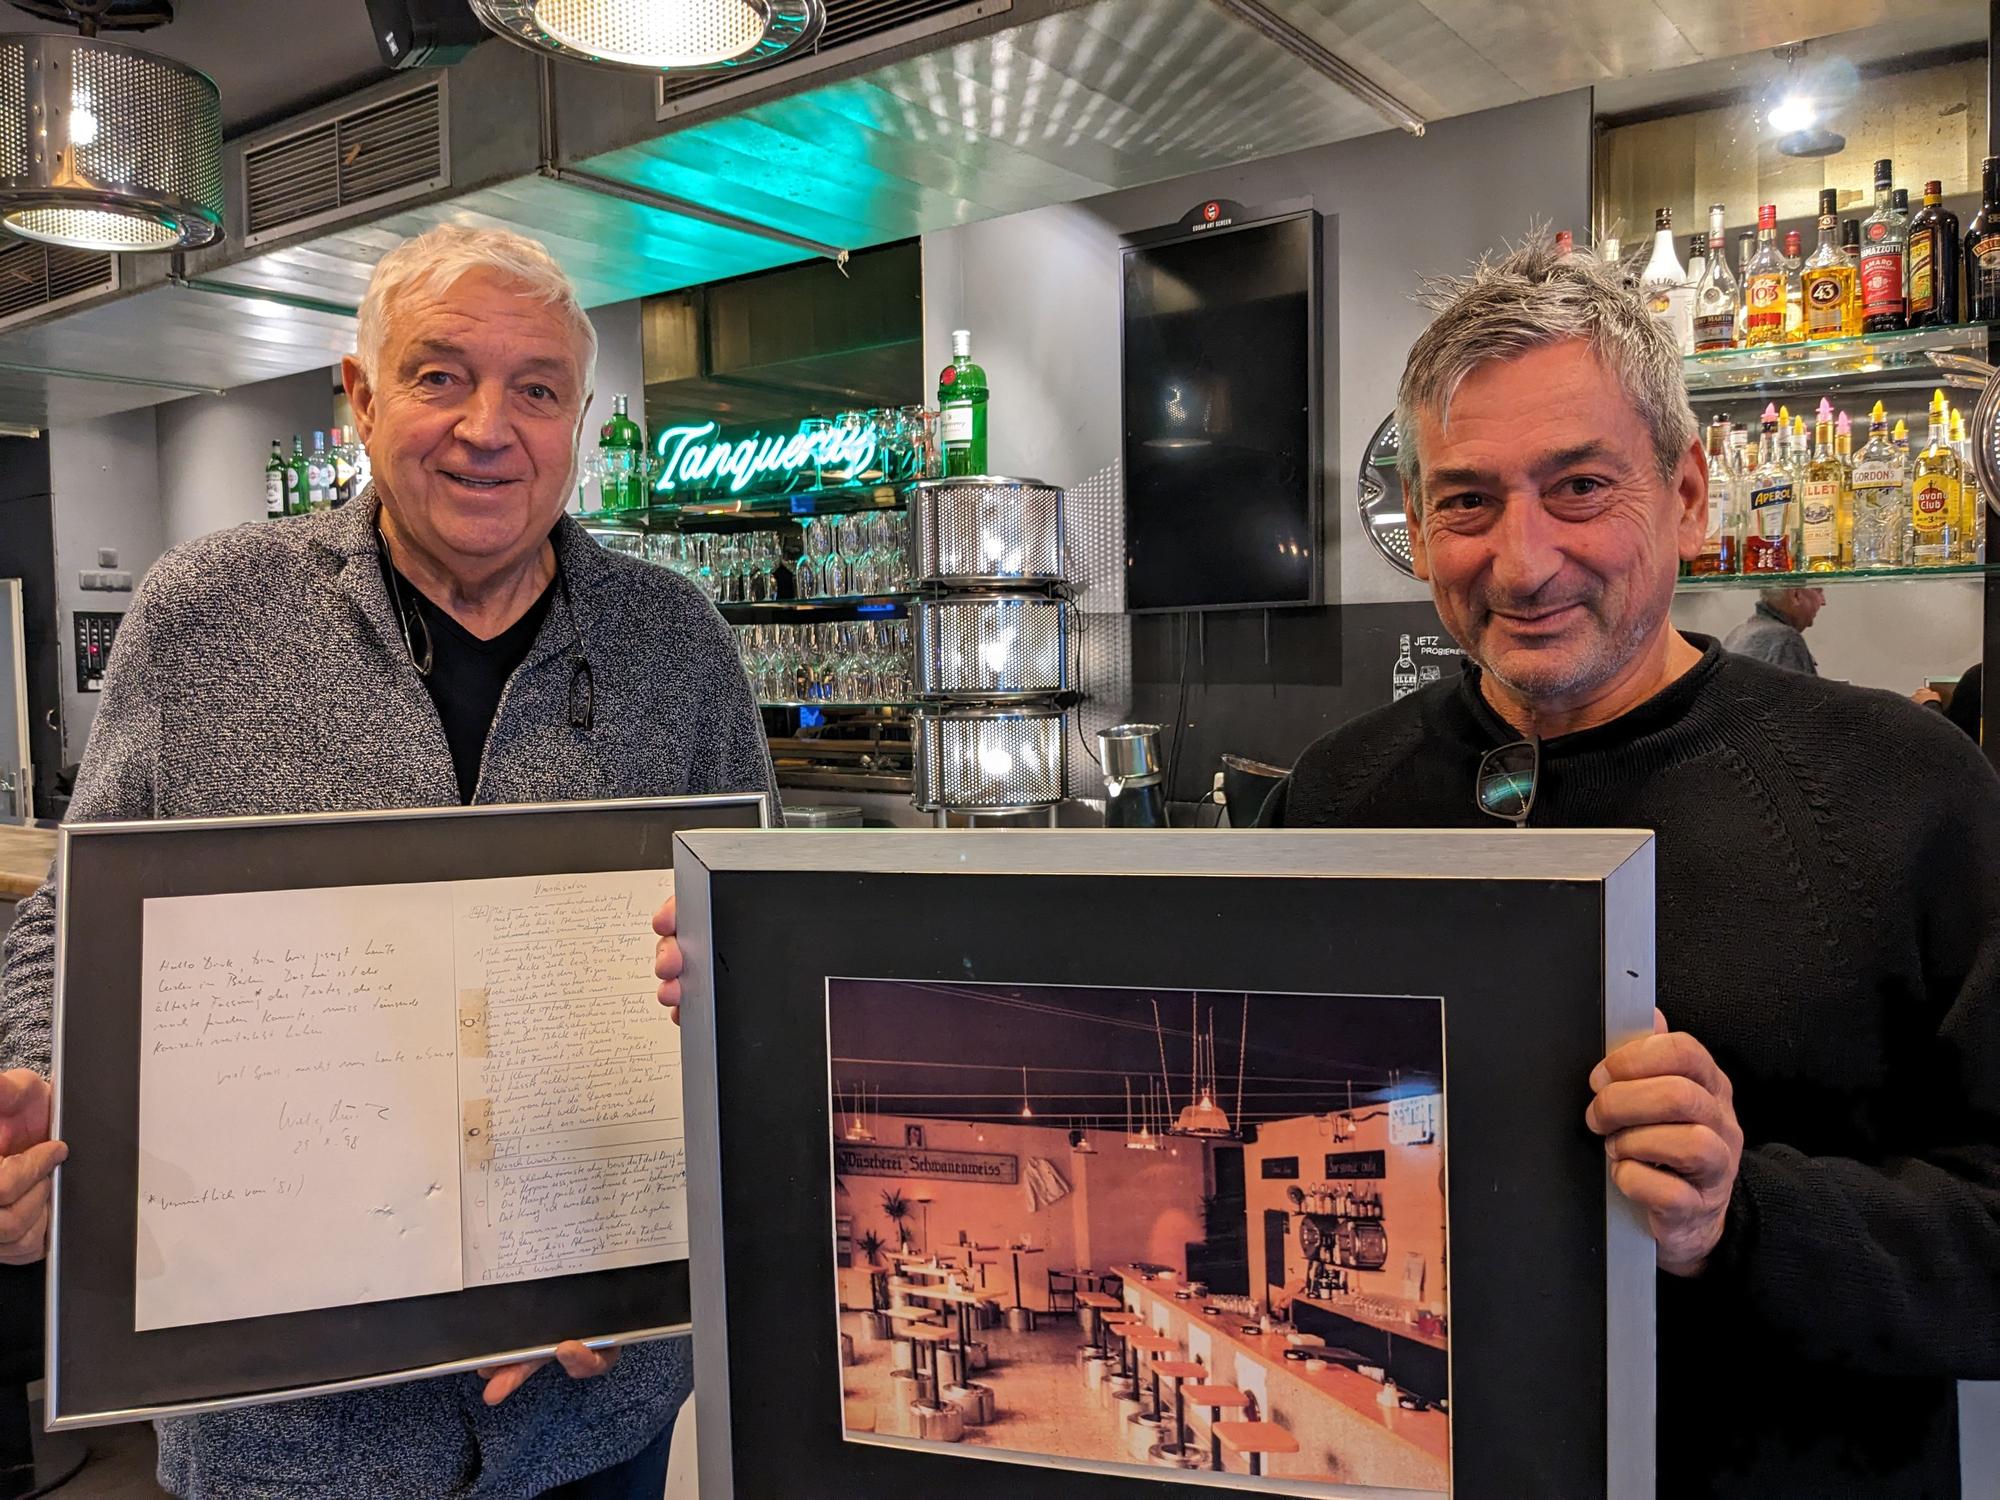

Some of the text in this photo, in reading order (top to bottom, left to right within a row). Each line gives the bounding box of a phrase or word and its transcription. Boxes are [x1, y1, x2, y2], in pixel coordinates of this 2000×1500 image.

[1215, 218, 1232, 228] SCREEN
[1864, 258, 1893, 271] AMARO
[1751, 285, 1779, 305] 103
[1812, 284, 1835, 300] 43
[657, 420, 881, 492] Tanqueray
[1754, 488, 1792, 507] APEROL
[1920, 499, 1942, 510] Club
